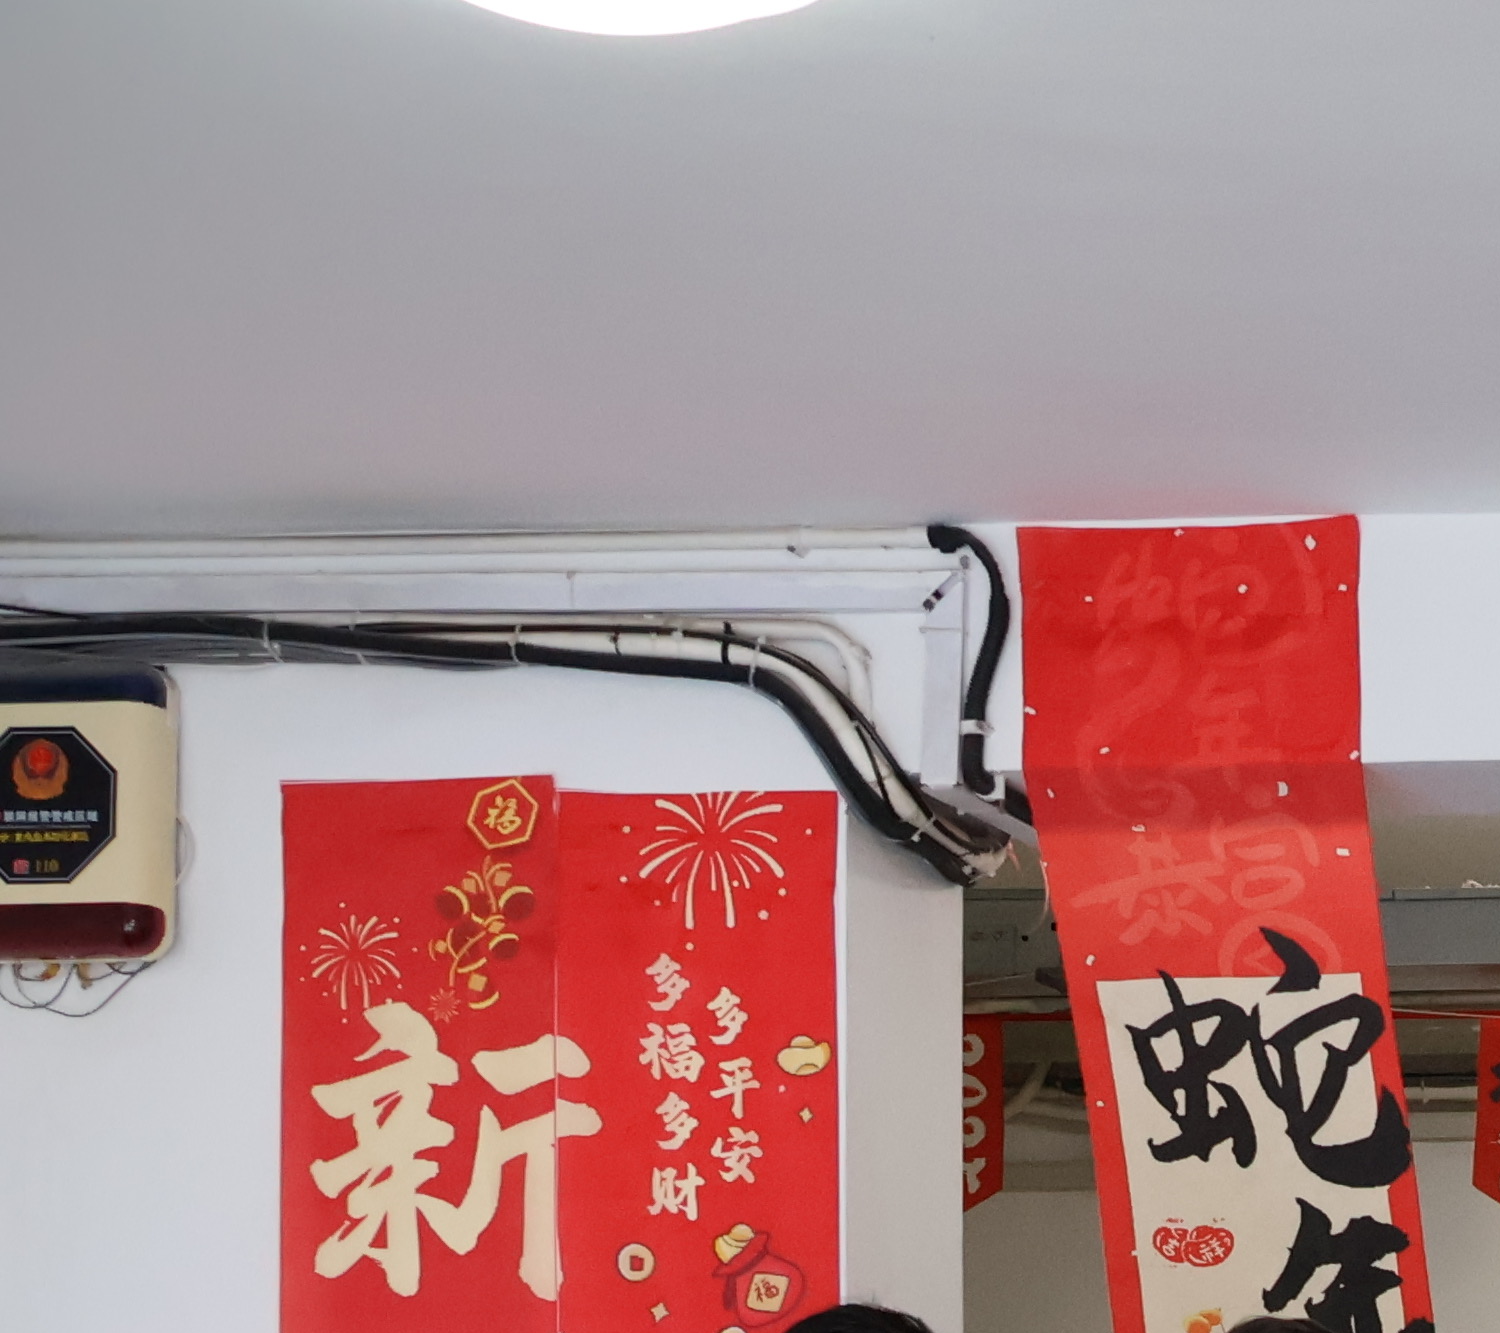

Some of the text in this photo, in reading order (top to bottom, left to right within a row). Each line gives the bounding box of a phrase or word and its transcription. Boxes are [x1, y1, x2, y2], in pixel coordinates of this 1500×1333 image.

[640, 953, 706, 1220] 多福多财
[706, 986, 764, 1184] 多平安
